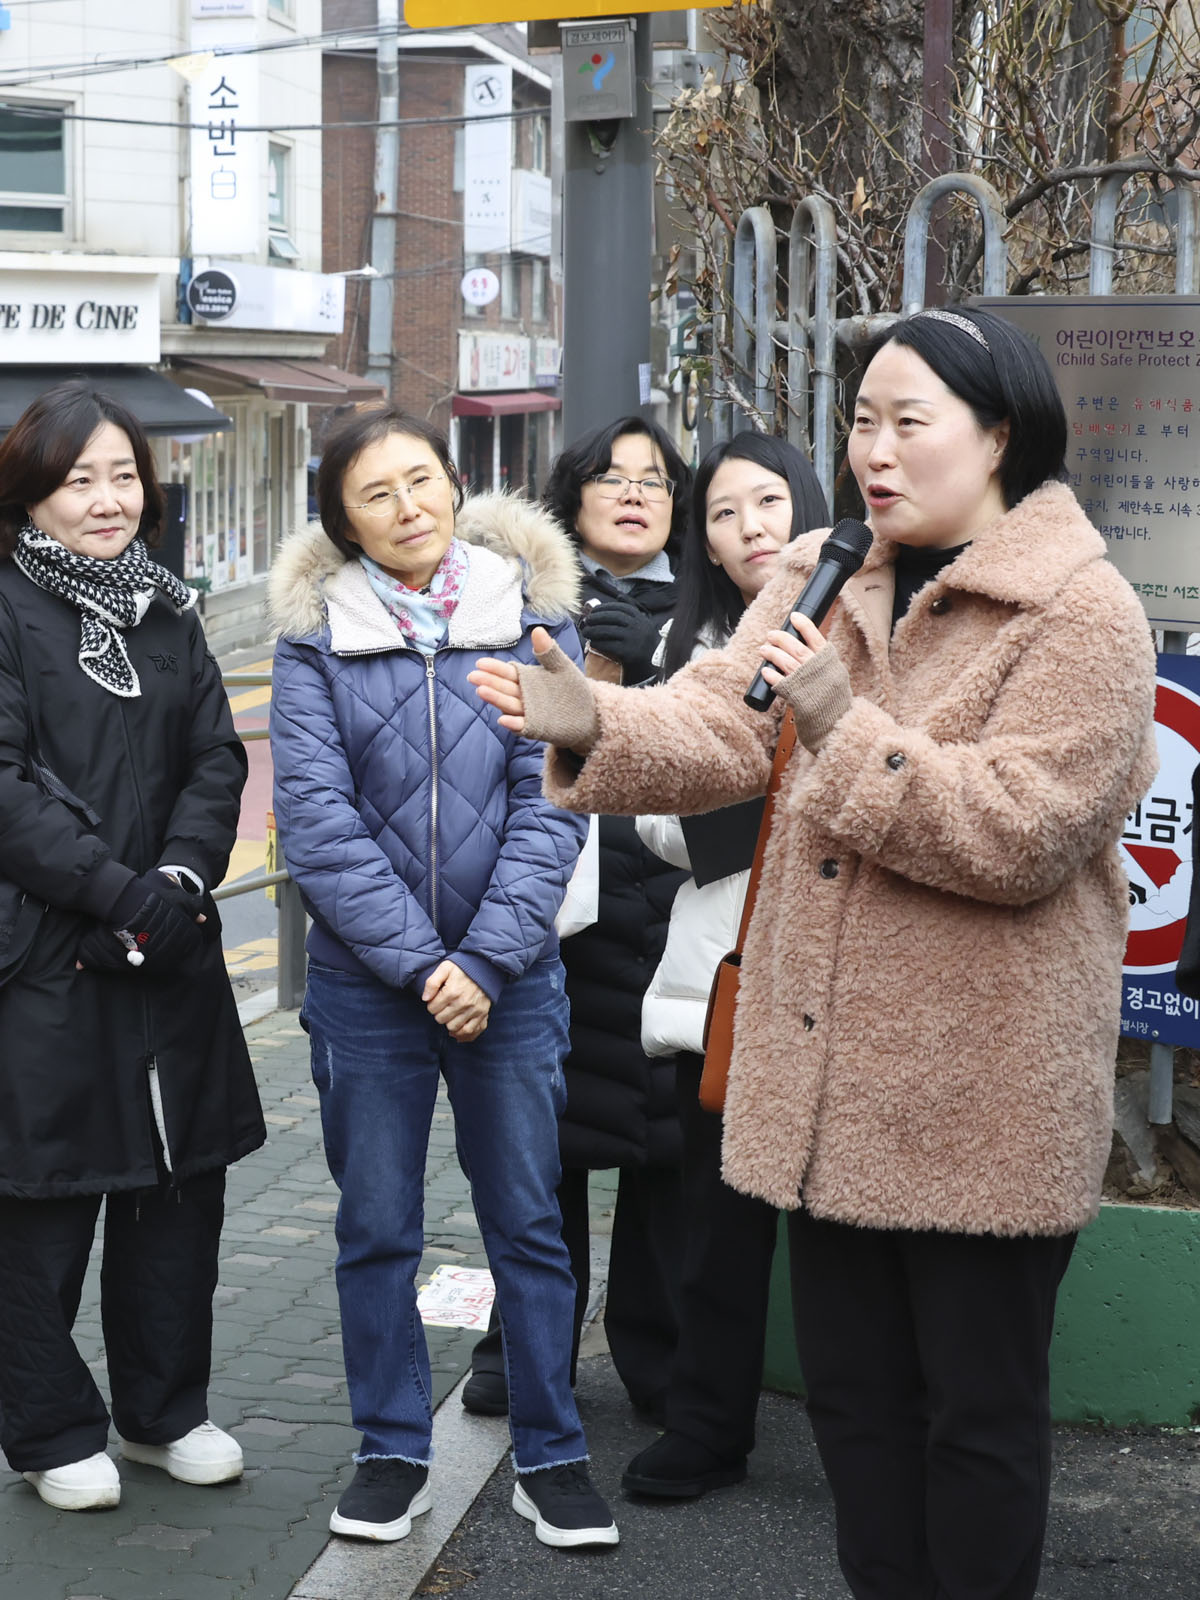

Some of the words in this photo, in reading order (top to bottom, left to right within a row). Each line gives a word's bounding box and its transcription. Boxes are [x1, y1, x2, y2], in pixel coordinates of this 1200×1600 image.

[31, 304, 66, 329] DE
[75, 301, 139, 330] CINE
[1056, 330, 1200, 349] 어린이안전보호
[1057, 353, 1095, 367] (Child
[1100, 353, 1133, 367] Safe
[1138, 353, 1190, 367] Protect
[1076, 397, 1120, 411] 주변은
[1076, 448, 1148, 463] 구역입니다.
[1090, 474, 1155, 490] 어린이들을
[1118, 501, 1164, 515] 제한속도
[1169, 502, 1193, 517] 시속
[1126, 987, 1200, 1020] 경고없이
